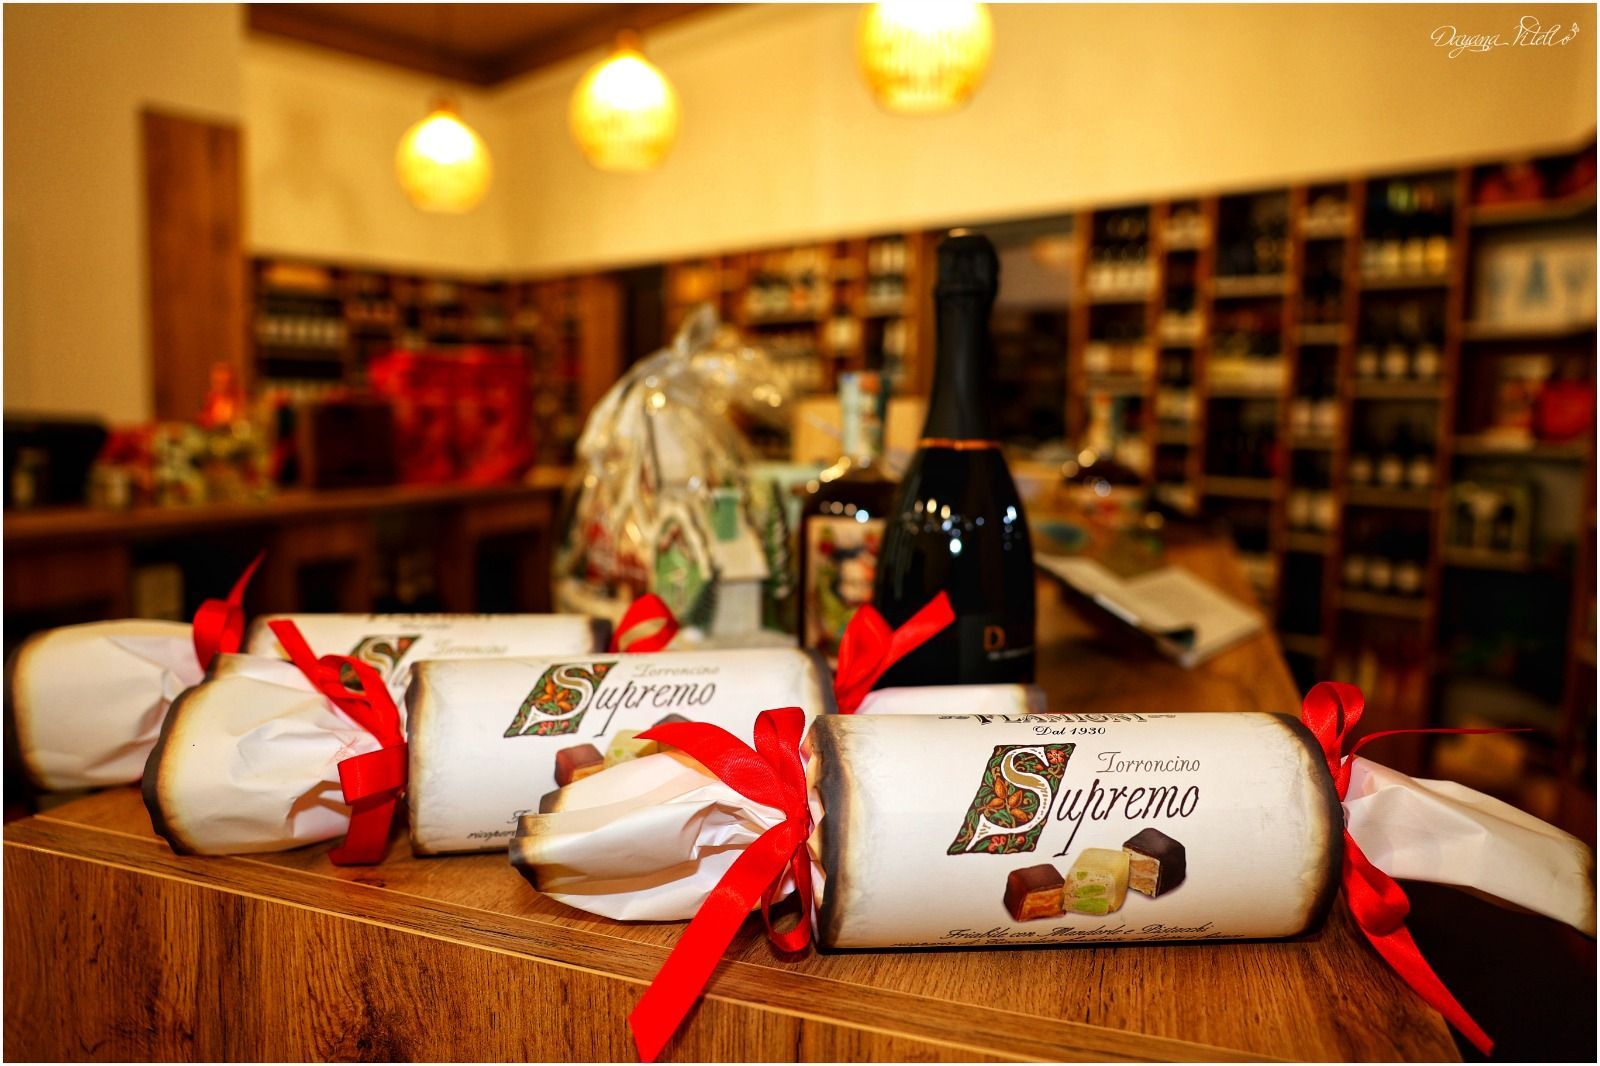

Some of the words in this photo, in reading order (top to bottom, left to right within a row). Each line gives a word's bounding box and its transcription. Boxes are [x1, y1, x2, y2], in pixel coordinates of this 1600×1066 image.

[983, 625, 1006, 653] D
[633, 663, 720, 678] Torroncino
[518, 662, 717, 738] Supremo
[1032, 725, 1066, 736] Dal
[1069, 725, 1106, 736] 1930
[1095, 750, 1201, 774] Torroncino
[962, 743, 1200, 858] Supremo
